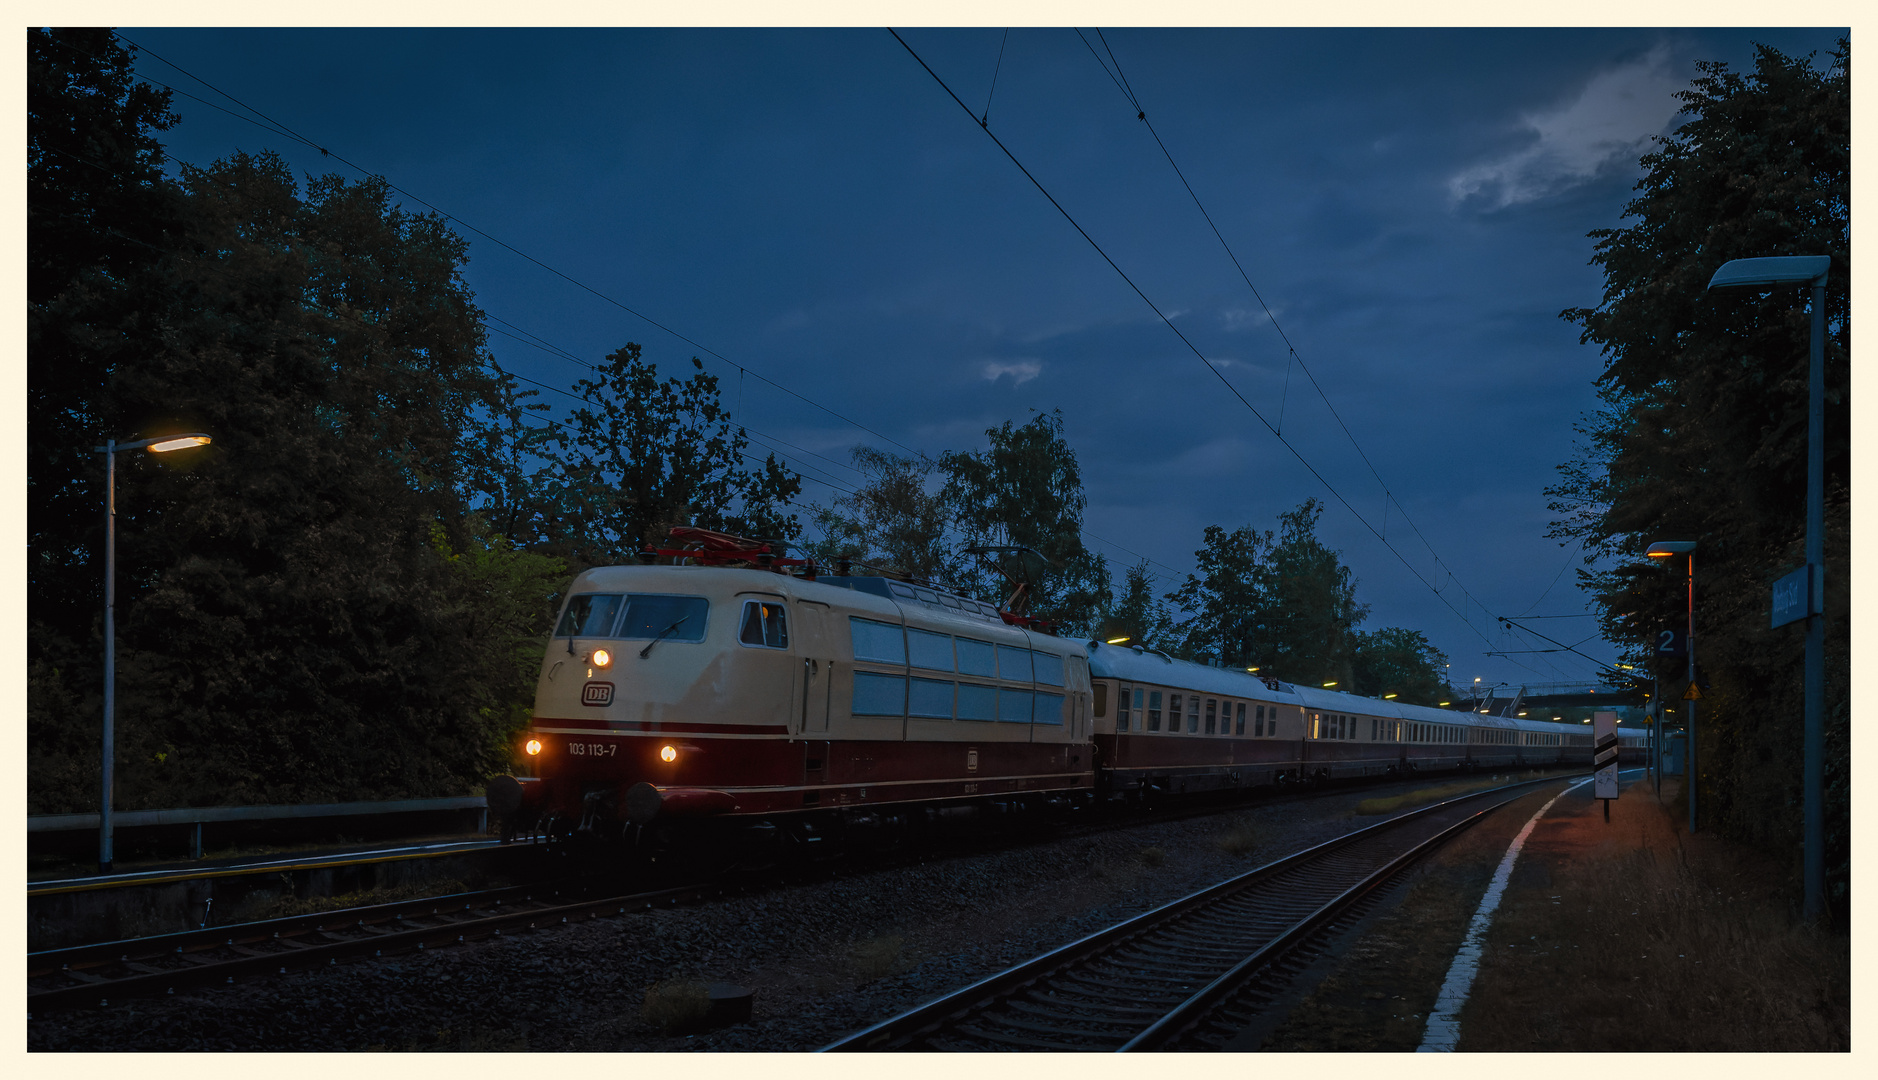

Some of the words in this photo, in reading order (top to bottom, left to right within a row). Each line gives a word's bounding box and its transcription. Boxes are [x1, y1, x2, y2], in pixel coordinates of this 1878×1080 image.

[1659, 630, 1675, 652] 2
[588, 688, 609, 700] DB
[569, 742, 585, 755] 103
[588, 743, 617, 757] 113-7
